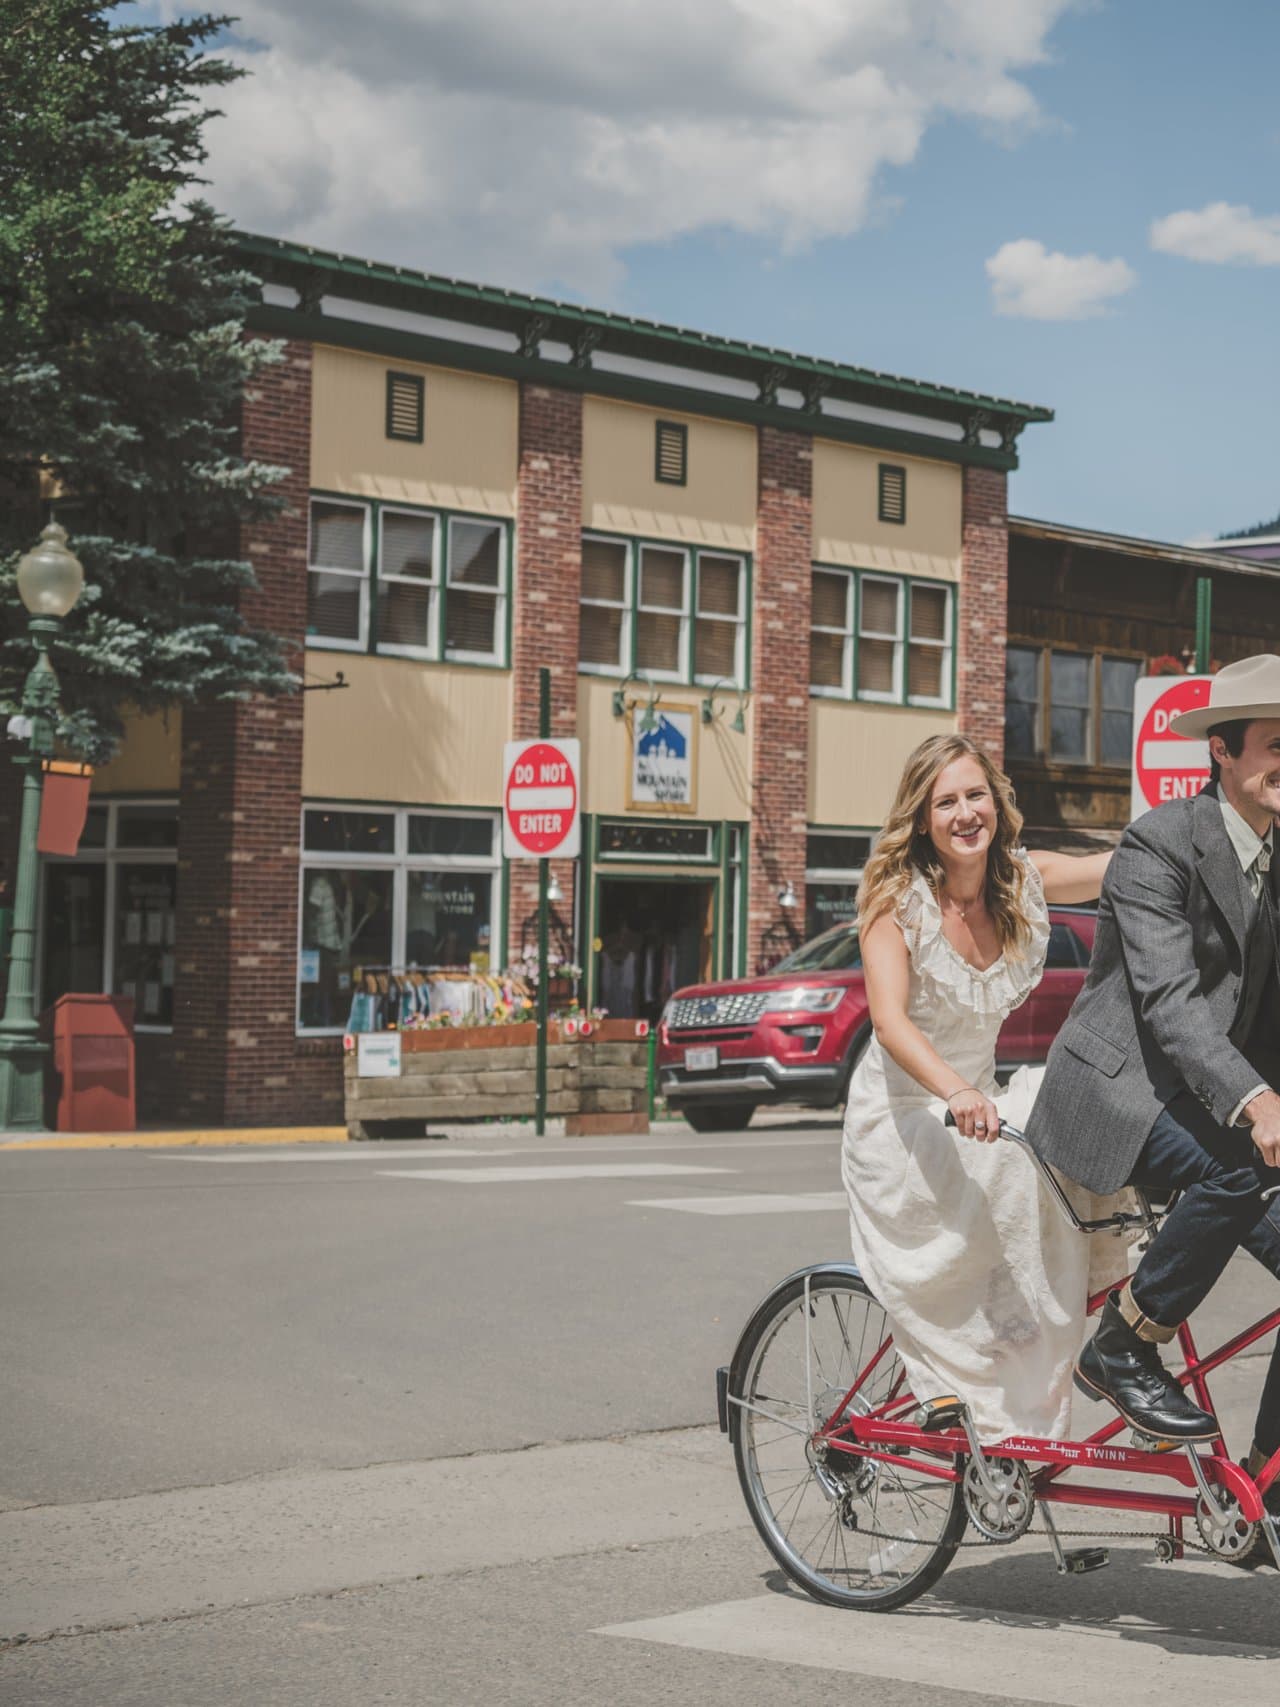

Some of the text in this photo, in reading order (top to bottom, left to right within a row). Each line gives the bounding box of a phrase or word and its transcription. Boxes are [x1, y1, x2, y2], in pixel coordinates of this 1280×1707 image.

[515, 763, 567, 784] DO NOT
[519, 814, 562, 834] ENTER
[1086, 1447, 1125, 1461] TWINN
